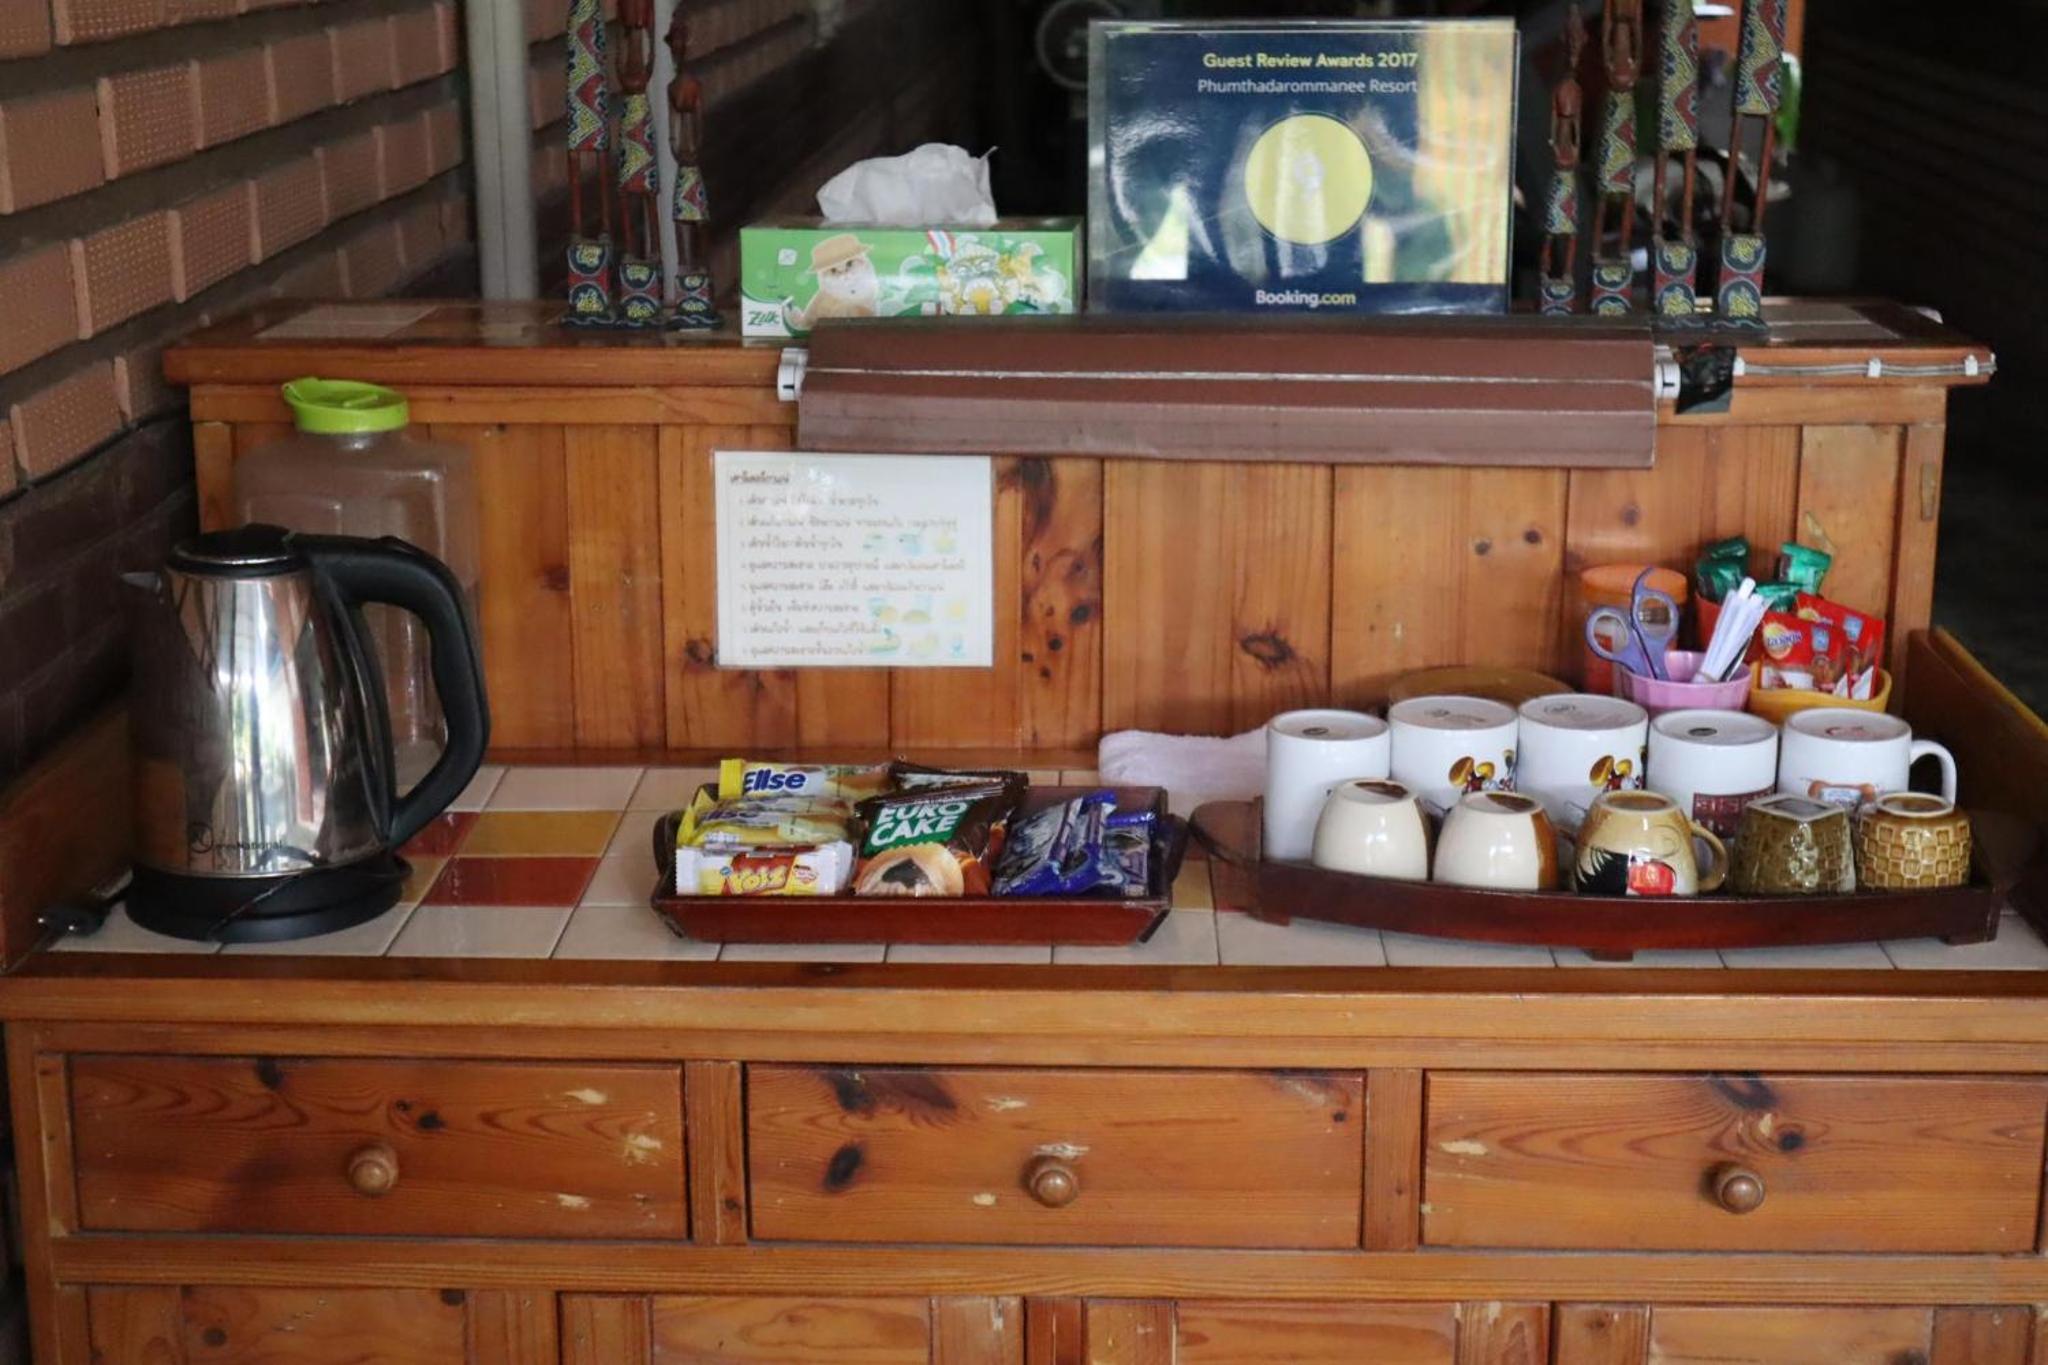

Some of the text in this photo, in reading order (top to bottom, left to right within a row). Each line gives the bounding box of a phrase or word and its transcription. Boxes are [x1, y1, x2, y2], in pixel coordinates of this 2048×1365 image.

[1202, 53, 1418, 68] Guest Review Awards 2017
[1198, 79, 1418, 94] Phumthadarommanee Resort
[1255, 289, 1356, 308] Booking.com
[876, 802, 969, 826] EURO
[870, 815, 960, 847] CAKE
